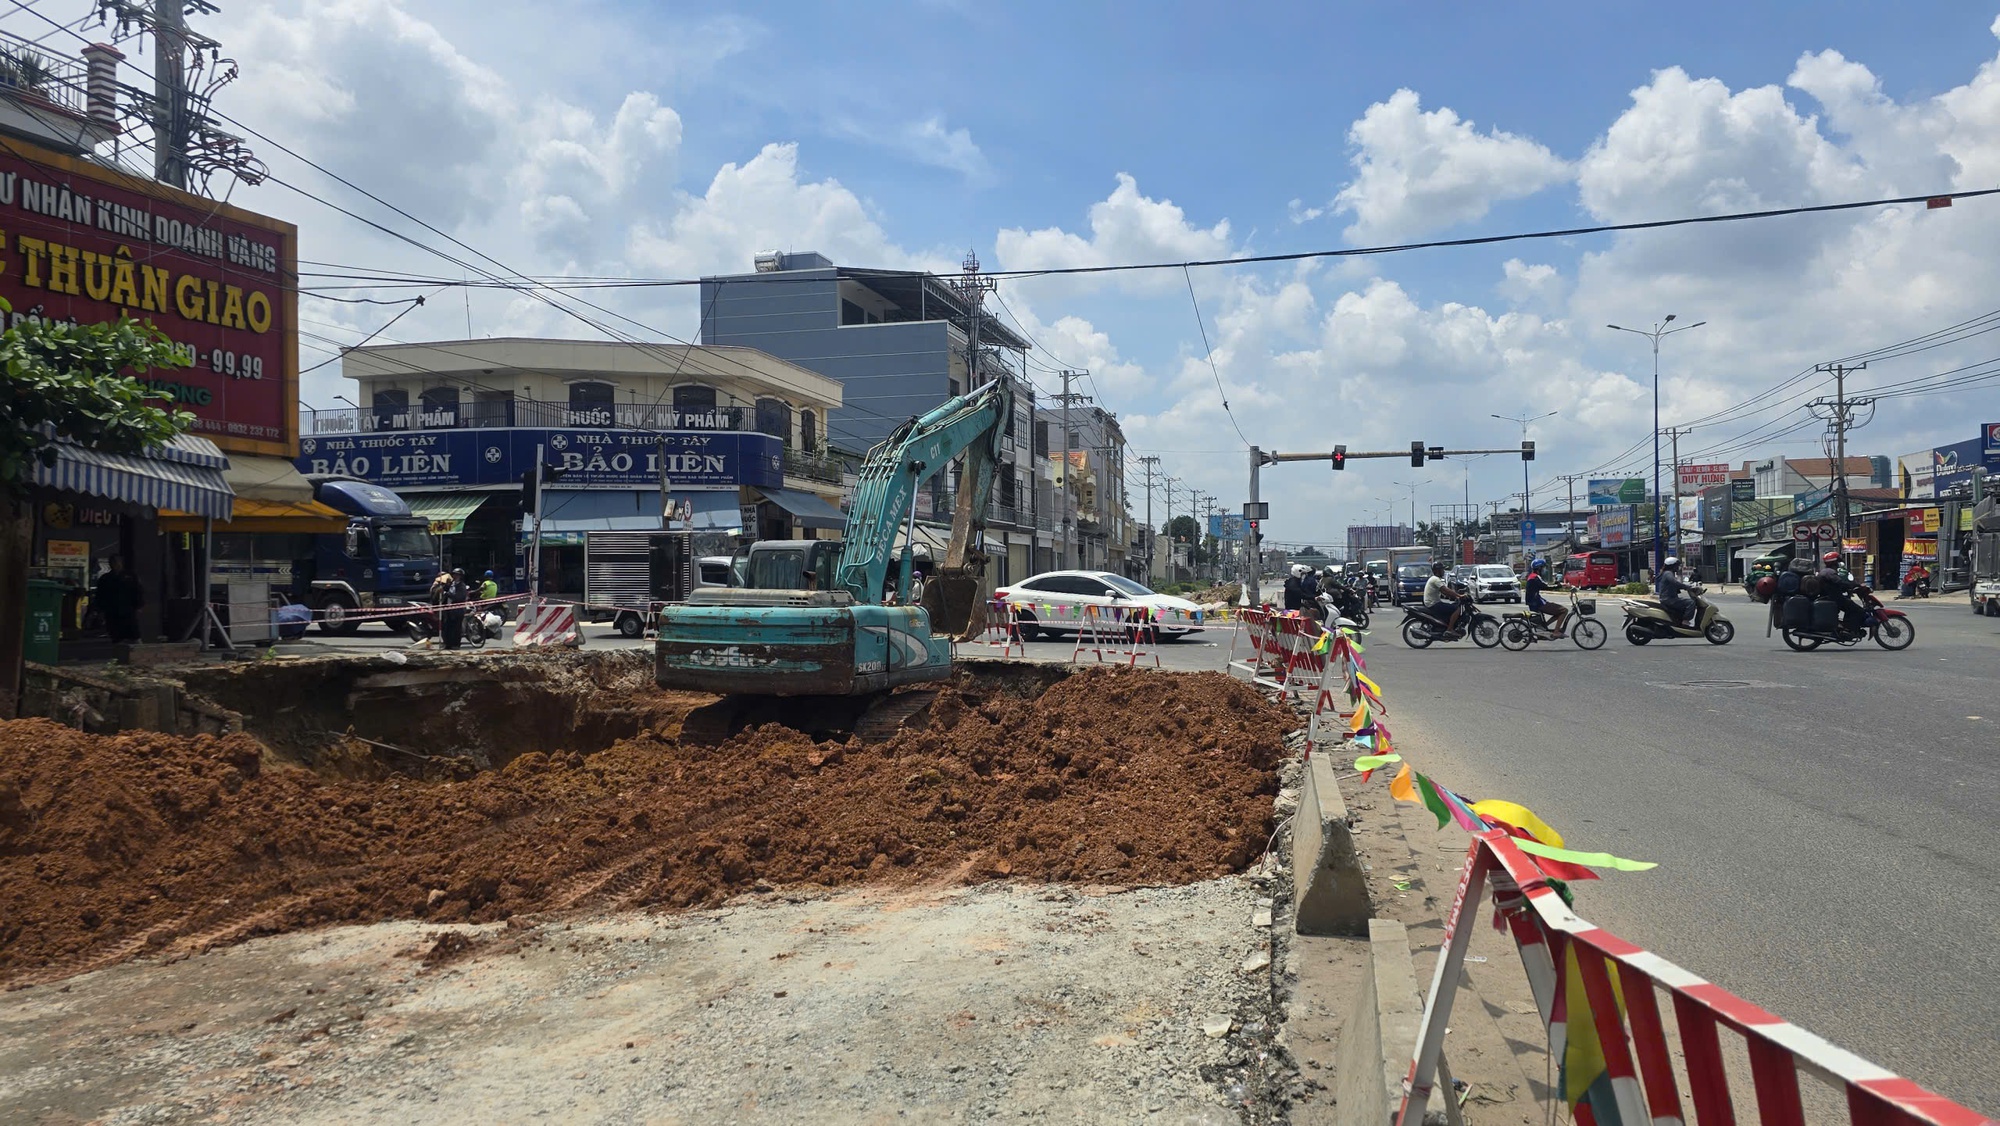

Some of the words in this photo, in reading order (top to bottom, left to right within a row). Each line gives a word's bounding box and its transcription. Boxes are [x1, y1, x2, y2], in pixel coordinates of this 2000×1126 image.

[22, 178, 92, 226] NHÂN
[97, 199, 151, 240] KINH
[155, 215, 223, 260] DOANH
[227, 232, 276, 273] VÀNG
[175, 274, 272, 334] GIAO
[213, 348, 262, 380] 99,99
[359, 413, 381, 430] TÂY
[392, 410, 413, 428] MỸ
[417, 406, 455, 427] PHẨM
[562, 407, 611, 426] THUỐC
[615, 408, 645, 427] TÂY
[657, 410, 681, 428] MỸ
[685, 408, 729, 428] PHẨM
[326, 438, 356, 450] NHÀ
[359, 434, 405, 448] THUỐC
[409, 434, 437, 447] TÂY
[575, 432, 613, 445] NHÀ
[619, 432, 675, 446] THUỐC
[679, 435, 711, 446] TÂY
[311, 450, 370, 476] BẢO
[381, 448, 452, 475] LIÊN
[561, 445, 633, 473] BẢO
[646, 450, 727, 473] LIÊN
[1682, 474, 1699, 484] DUY
[1702, 473, 1726, 483] HƯNG
[858, 661, 882, 673] SK200
